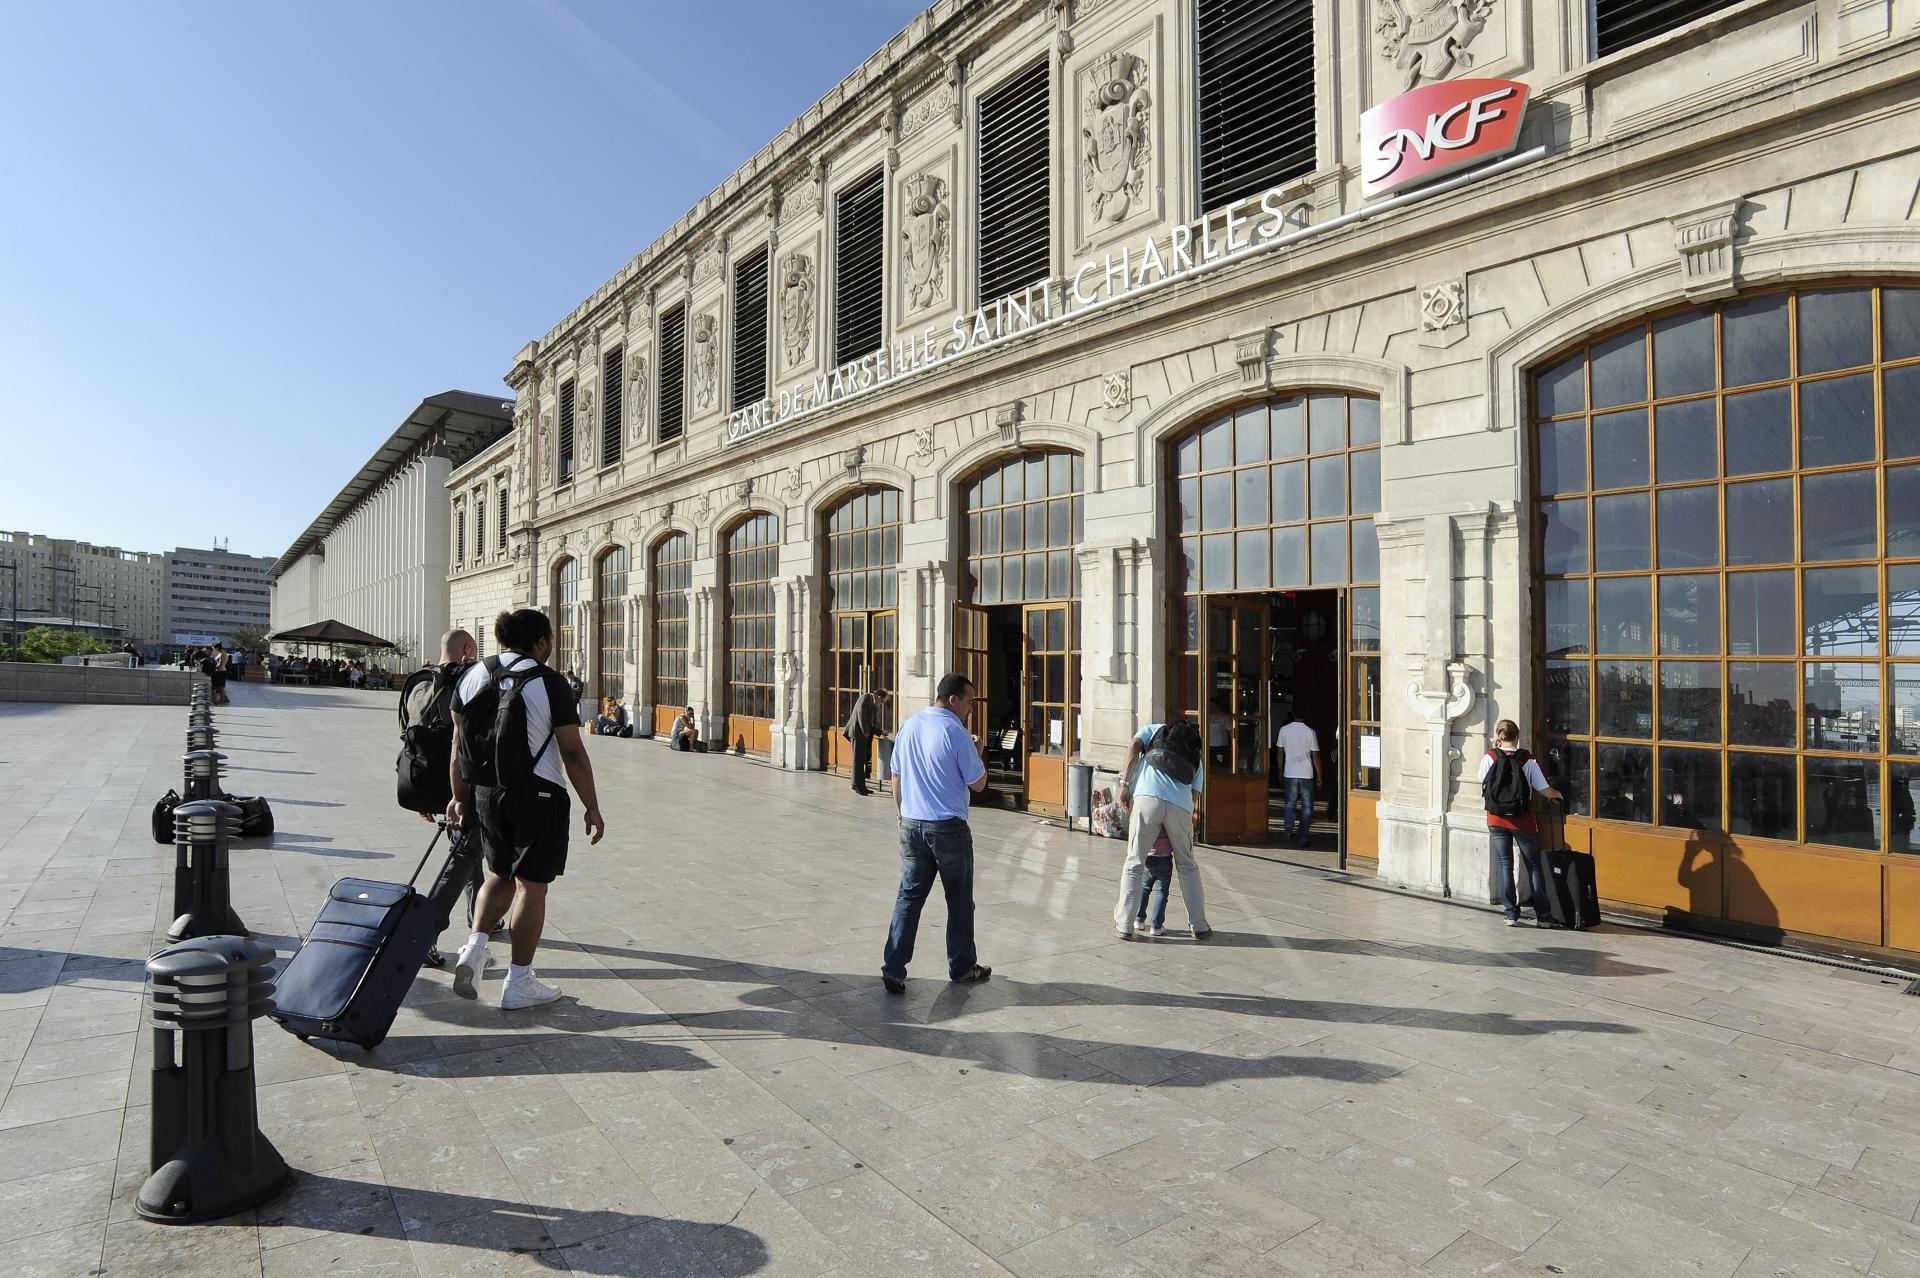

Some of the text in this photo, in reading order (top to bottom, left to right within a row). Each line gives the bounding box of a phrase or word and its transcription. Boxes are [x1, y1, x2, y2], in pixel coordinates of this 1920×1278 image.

[1367, 86, 1515, 185] SNCF
[727, 187, 1286, 439] GARE DE MARSEILLE SAINT CHARLES
